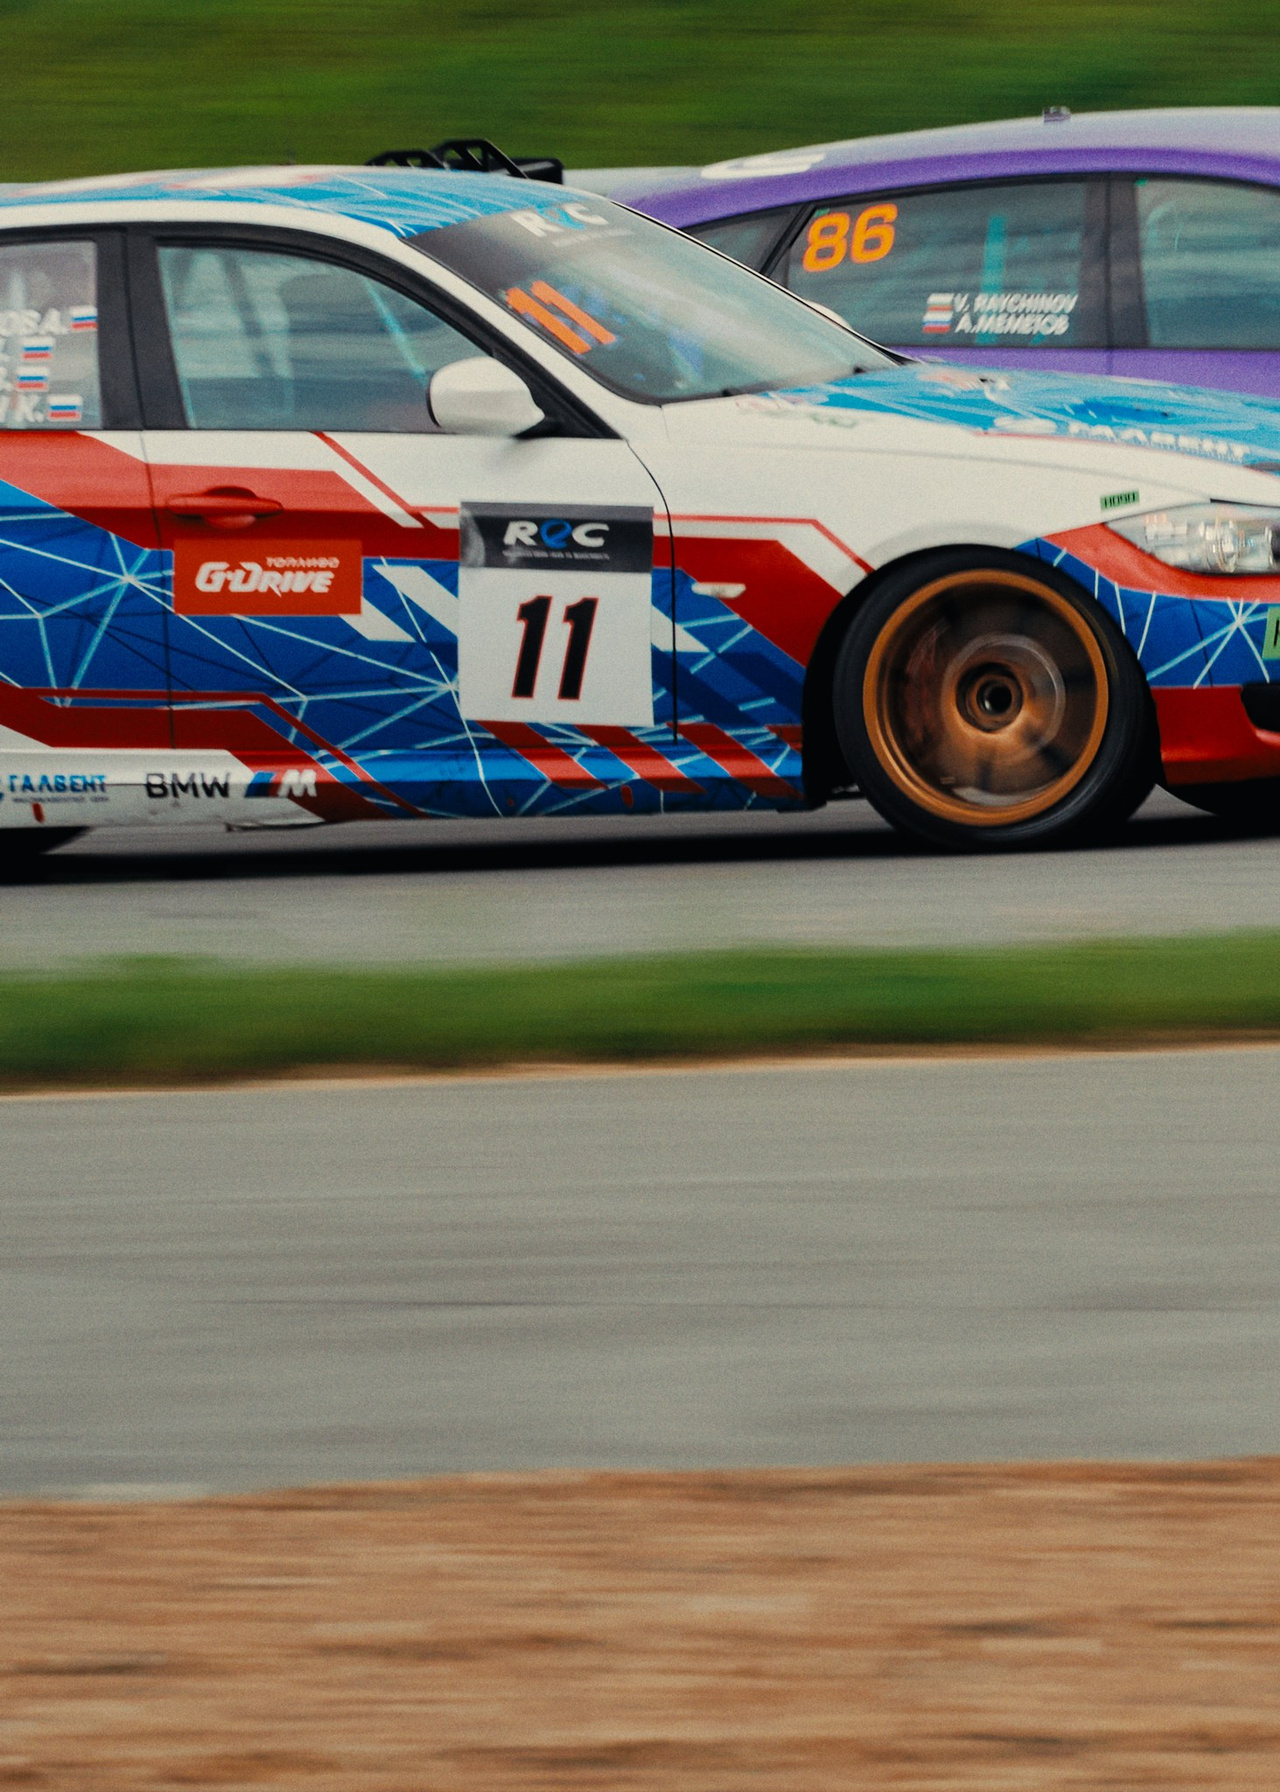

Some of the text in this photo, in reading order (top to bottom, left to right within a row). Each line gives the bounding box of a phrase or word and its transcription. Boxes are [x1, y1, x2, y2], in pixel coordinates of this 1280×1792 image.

[802, 203, 898, 272] 86
[505, 280, 617, 355] 11
[511, 595, 599, 700] 11
[146, 773, 230, 798] BMW
